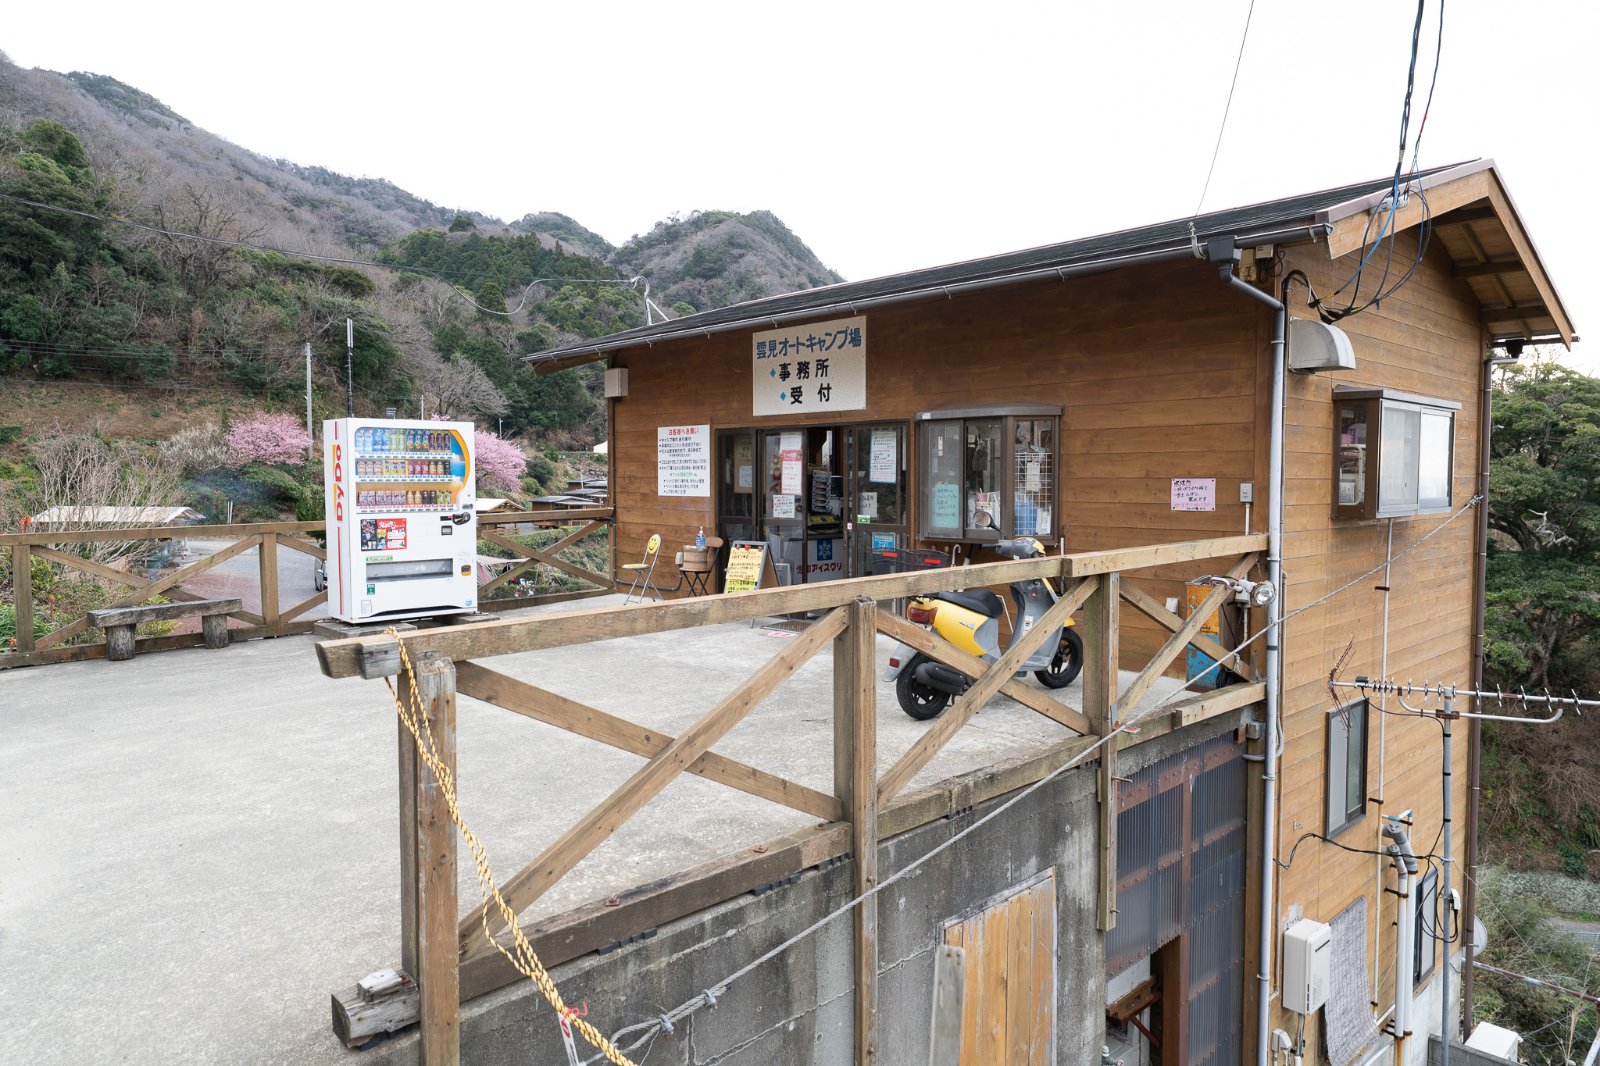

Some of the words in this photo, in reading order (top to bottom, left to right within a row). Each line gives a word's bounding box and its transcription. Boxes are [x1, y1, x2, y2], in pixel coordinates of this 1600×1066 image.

[757, 326, 862, 359] 雲見オートキャンプ場
[779, 358, 829, 382] 事務所
[790, 383, 832, 405] 受付
